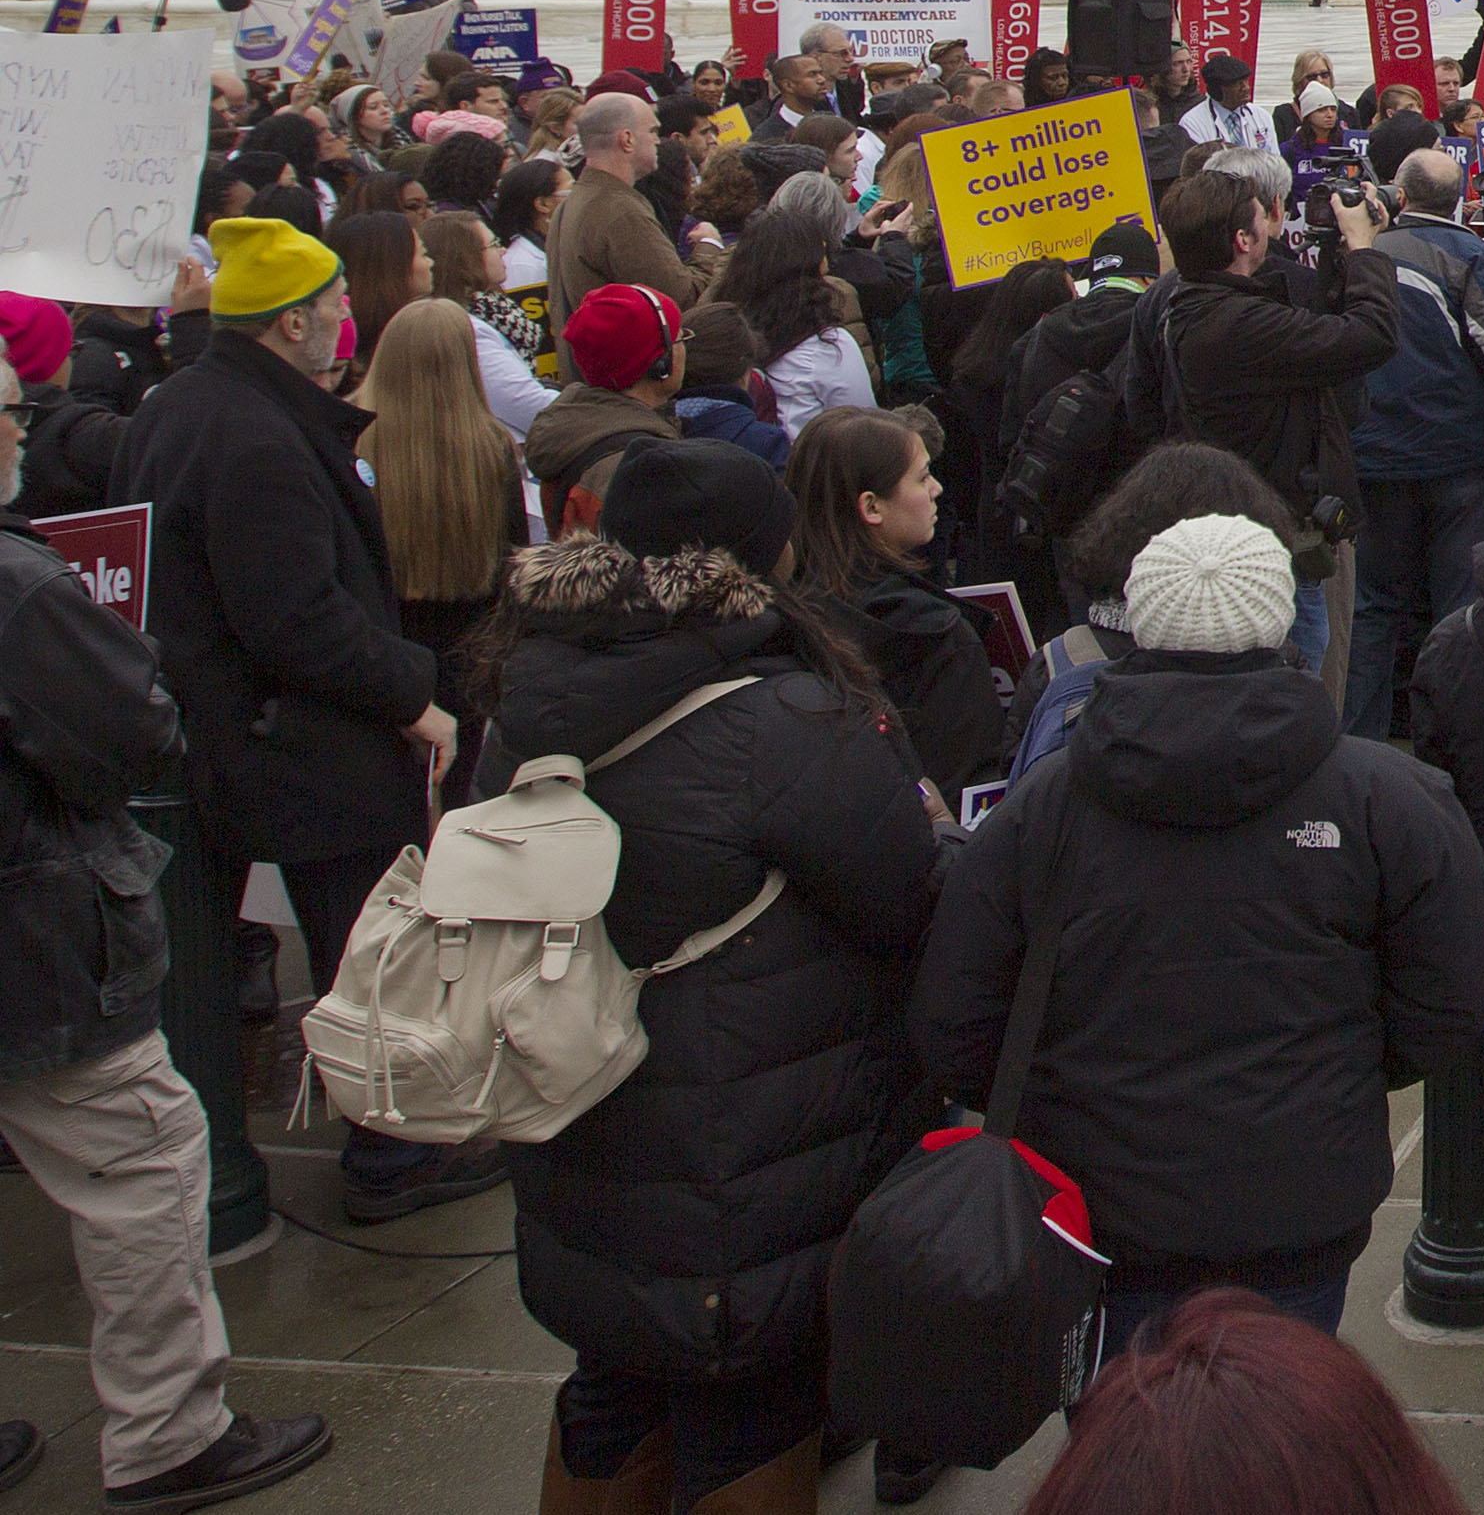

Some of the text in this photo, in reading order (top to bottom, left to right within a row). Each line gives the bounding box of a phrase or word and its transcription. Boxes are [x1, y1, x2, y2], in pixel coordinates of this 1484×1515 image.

[814, 10, 957, 21] #DONTTAKEMYCARE
[870, 29, 934, 45] DOCTORS
[1376, 9, 1391, 61] HEALTHCARE
[472, 46, 519, 60] ANA
[872, 45, 892, 58] FOR
[961, 118, 1102, 164] 8+ million
[968, 149, 1109, 195] could lose
[976, 183, 1114, 227] coverage.
[963, 228, 1093, 273] #KingVBurwell
[1304, 821, 1323, 831] THE
[1286, 830, 1323, 839] NORTH
[1296, 838, 1323, 848] FACE
